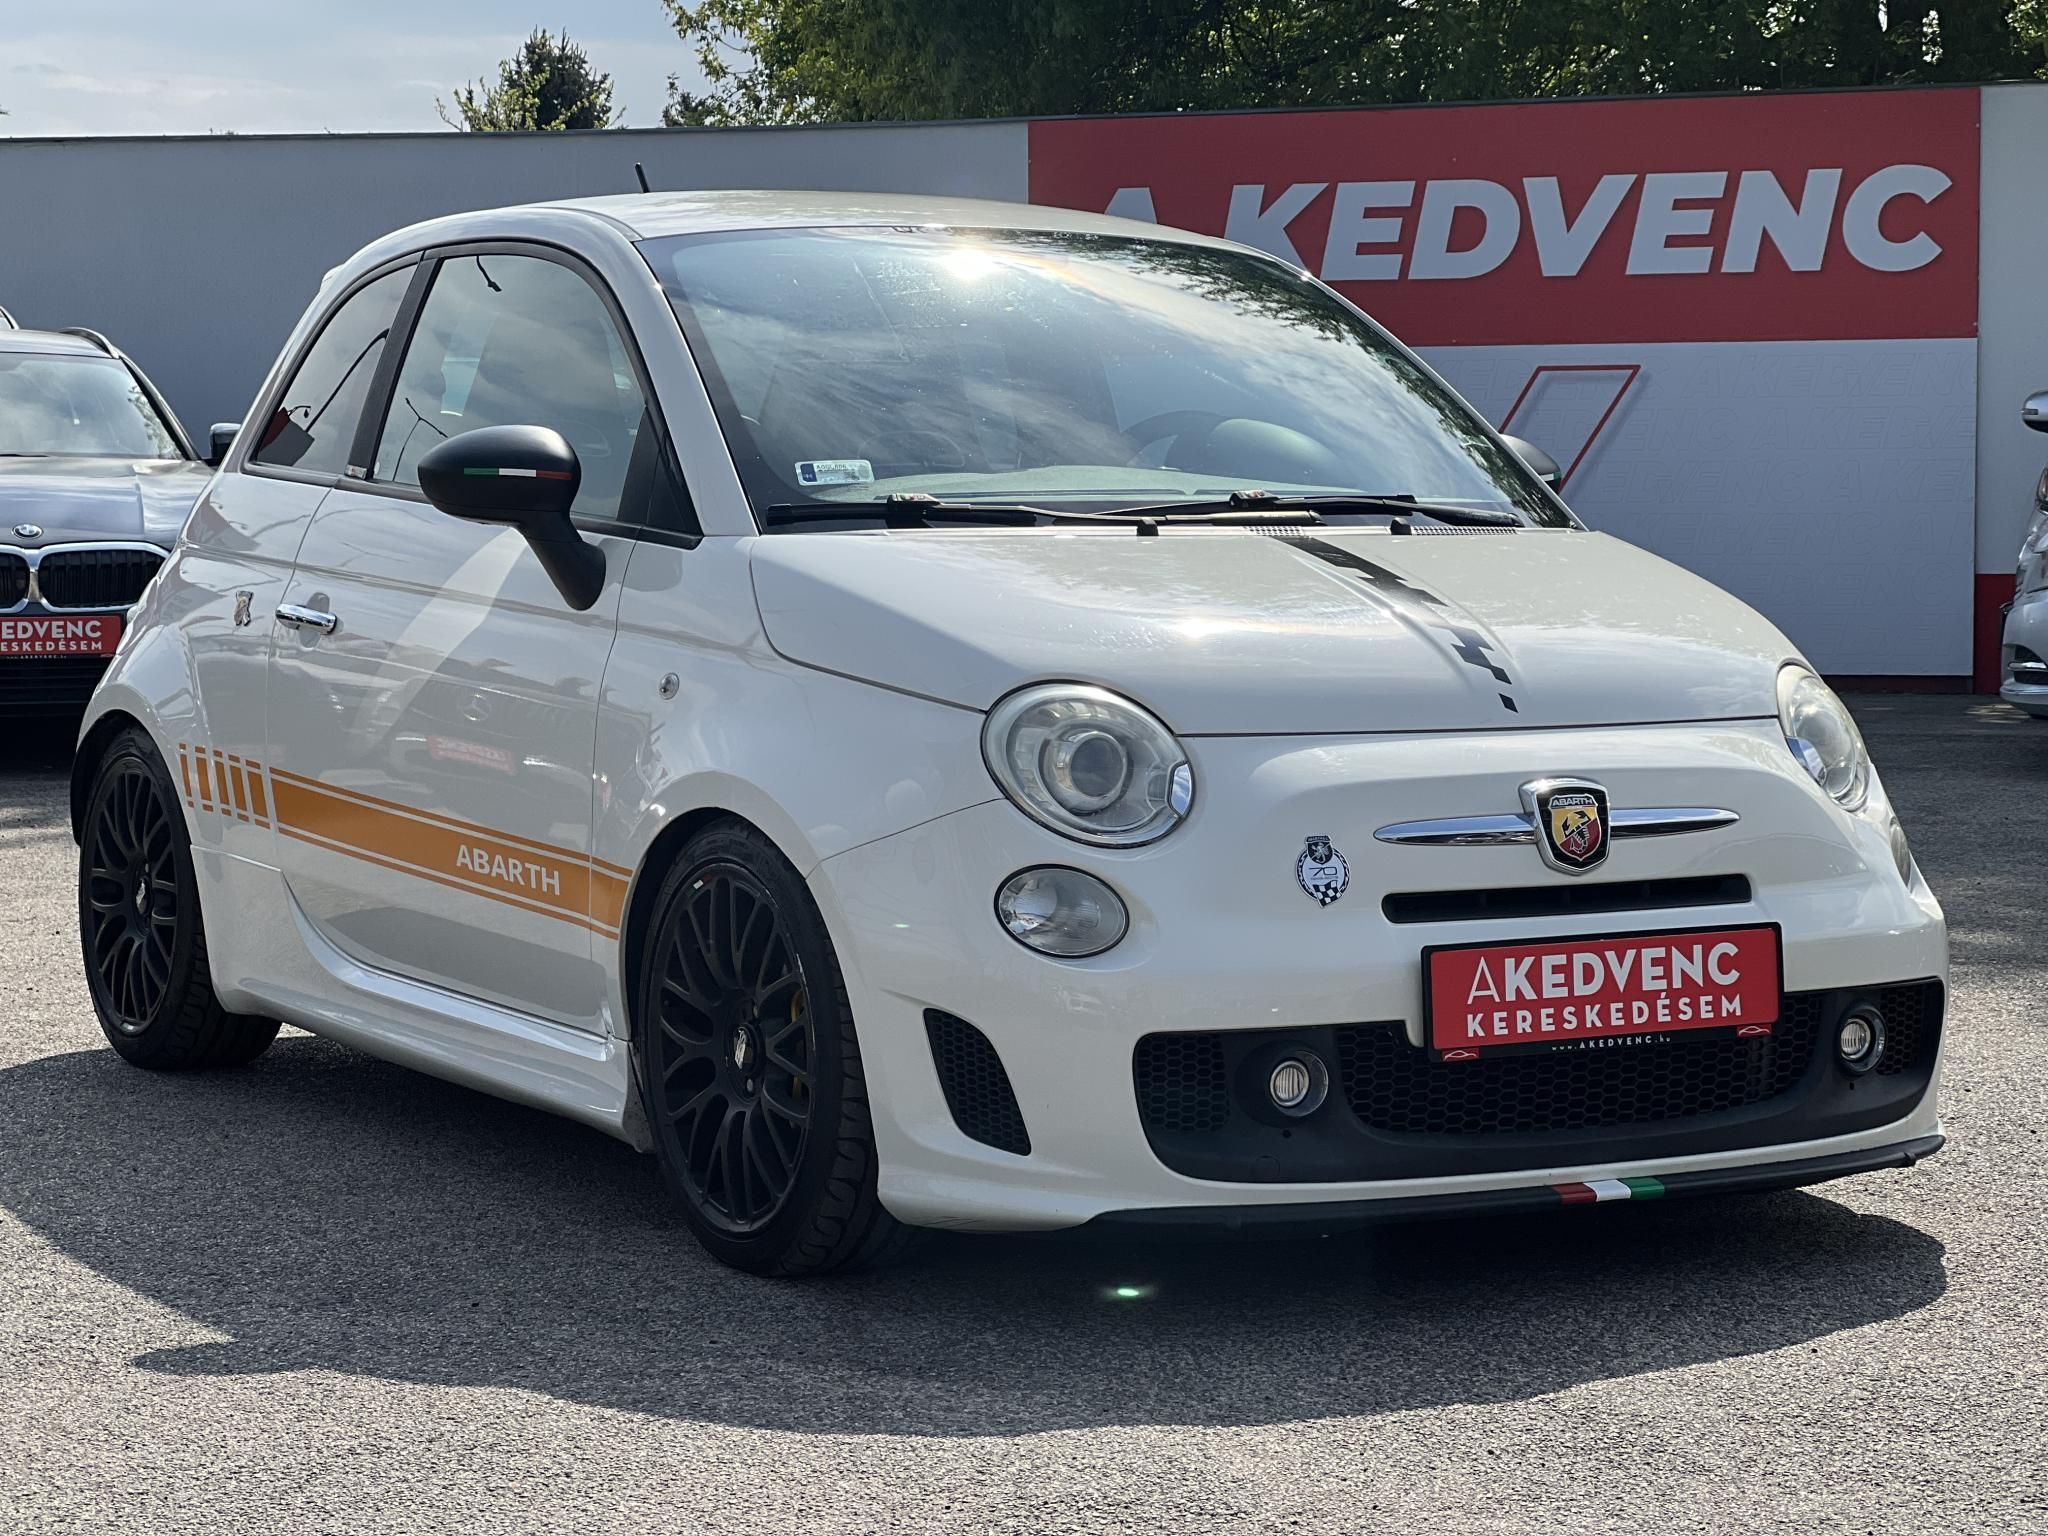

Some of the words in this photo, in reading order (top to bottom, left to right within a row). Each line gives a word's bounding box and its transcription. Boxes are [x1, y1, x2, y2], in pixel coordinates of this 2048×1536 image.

[1224, 163, 1953, 281] KEDVENC
[1552, 797, 1593, 806] ABARTH
[456, 844, 560, 896] ABARTH
[1309, 866, 1338, 877] 70
[1467, 992, 1742, 1038] KERESKEDÉSEM
